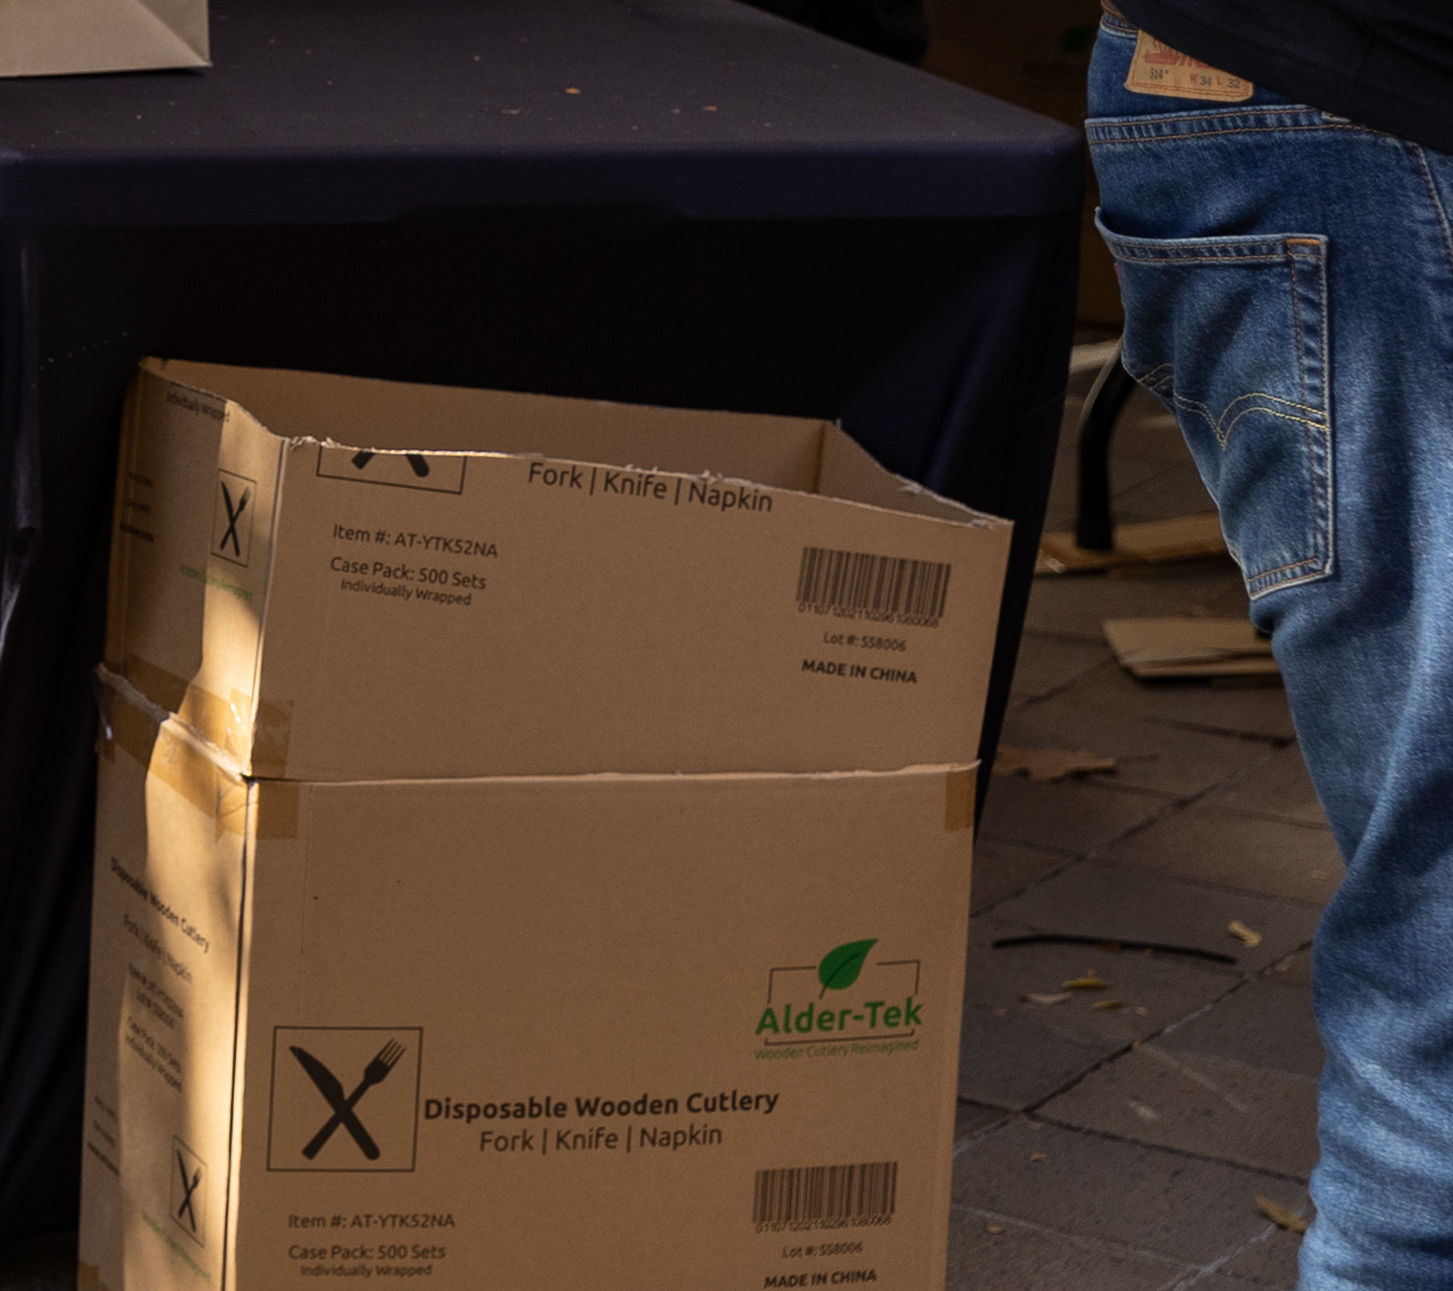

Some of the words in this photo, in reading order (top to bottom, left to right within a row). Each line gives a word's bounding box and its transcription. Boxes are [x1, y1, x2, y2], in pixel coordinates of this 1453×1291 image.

[1200, 75, 1213, 86] 34
[1227, 78, 1241, 89] 32
[528, 462, 584, 490] Fork
[602, 470, 669, 501] Knife
[687, 480, 774, 514] Napkin
[332, 524, 371, 544] Item
[394, 532, 499, 559] AT-YTK52NA
[330, 556, 371, 578] Case
[372, 562, 416, 583] Pack:
[419, 568, 449, 586] 500
[452, 572, 488, 591] Sets
[341, 578, 414, 601] Individually
[414, 589, 473, 608] Wrapped
[823, 631, 844, 646] Lot
[801, 659, 847, 677] MADE
[849, 664, 867, 679] IN
[869, 666, 918, 685] CHINA
[754, 995, 924, 1036] Alder-Tek
[423, 1096, 568, 1124] Disposable
[574, 1093, 679, 1118] Wooden
[685, 1089, 781, 1115] Cutlery
[478, 1128, 536, 1153] Fork
[554, 1126, 619, 1152] Knife
[639, 1124, 723, 1152] Napkin
[287, 1213, 327, 1229] Item
[287, 1244, 329, 1260] Case
[329, 1244, 374, 1260] Pack:
[376, 1245, 408, 1260] 500
[410, 1244, 447, 1260] Sets
[299, 1264, 374, 1279] Individually
[375, 1264, 433, 1278] Wrapped
[763, 1274, 809, 1290] MADE
[810, 1271, 828, 1286] IN
[829, 1268, 878, 1285] CHINA
